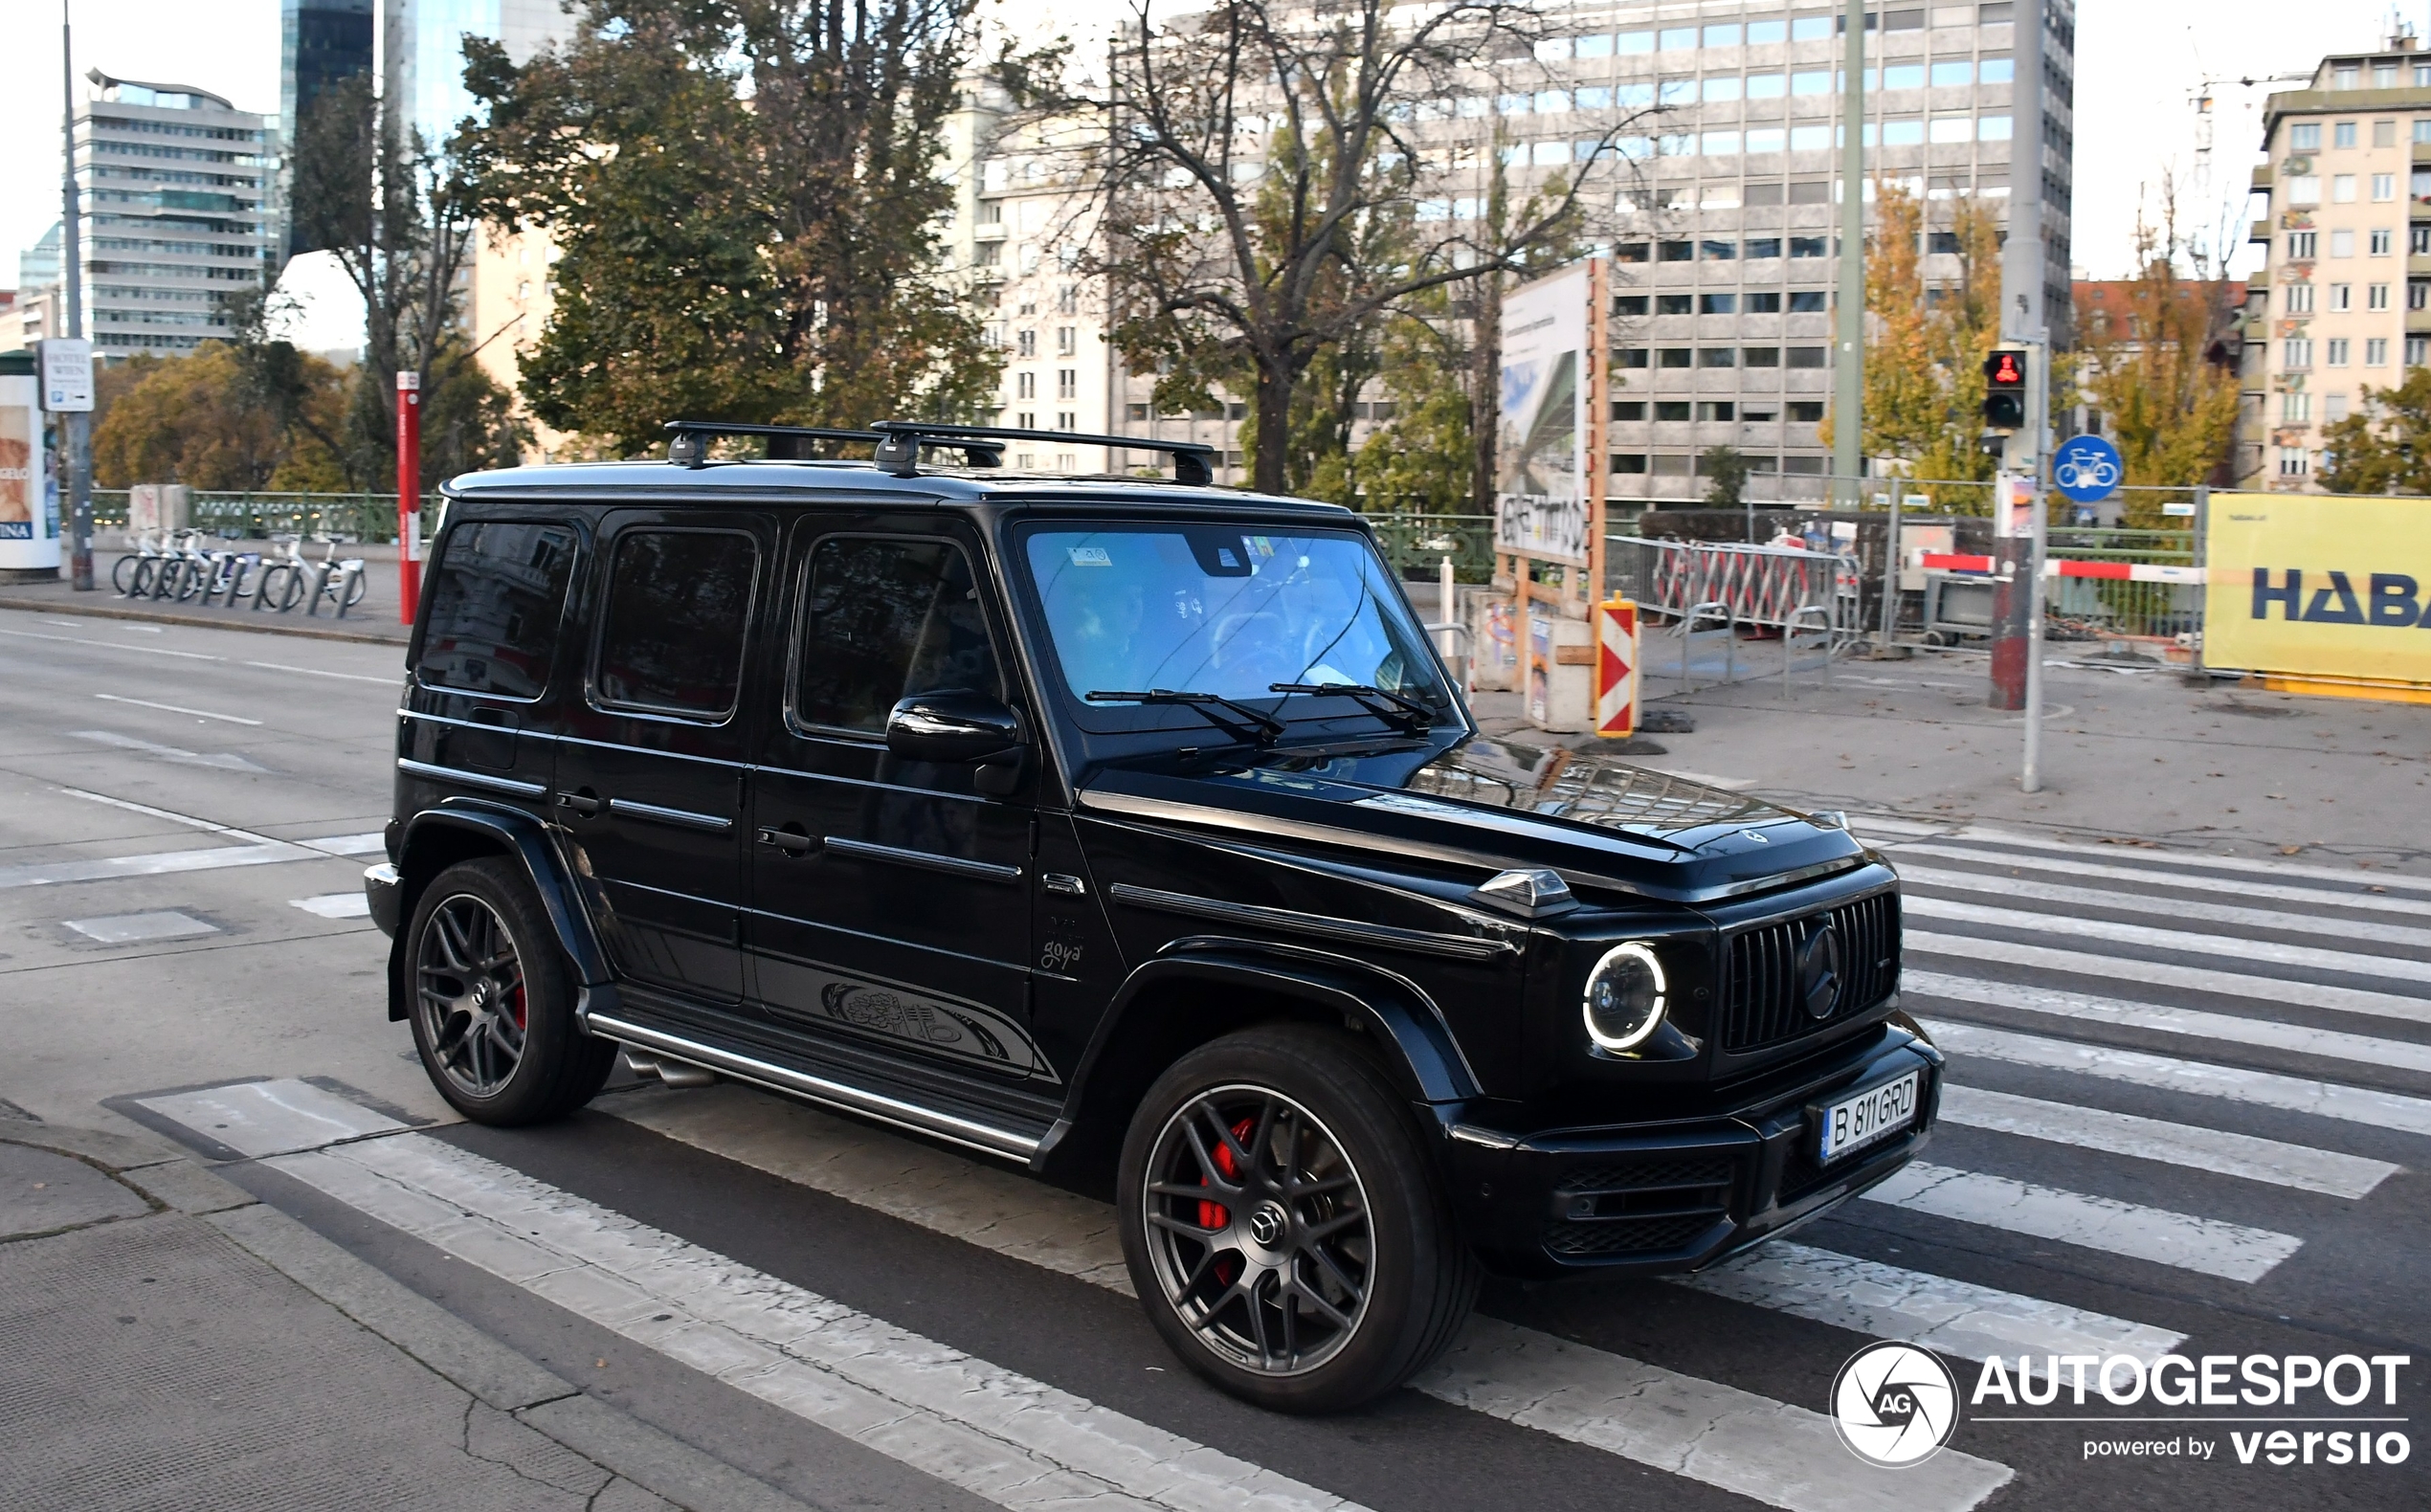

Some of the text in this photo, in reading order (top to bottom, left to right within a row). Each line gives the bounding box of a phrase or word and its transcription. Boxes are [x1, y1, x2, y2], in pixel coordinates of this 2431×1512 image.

[47, 353, 87, 364] HOTEL
[2251, 567, 2431, 629] HAB
[1040, 941, 1081, 970] goya
[1835, 1107, 1848, 1146] B
